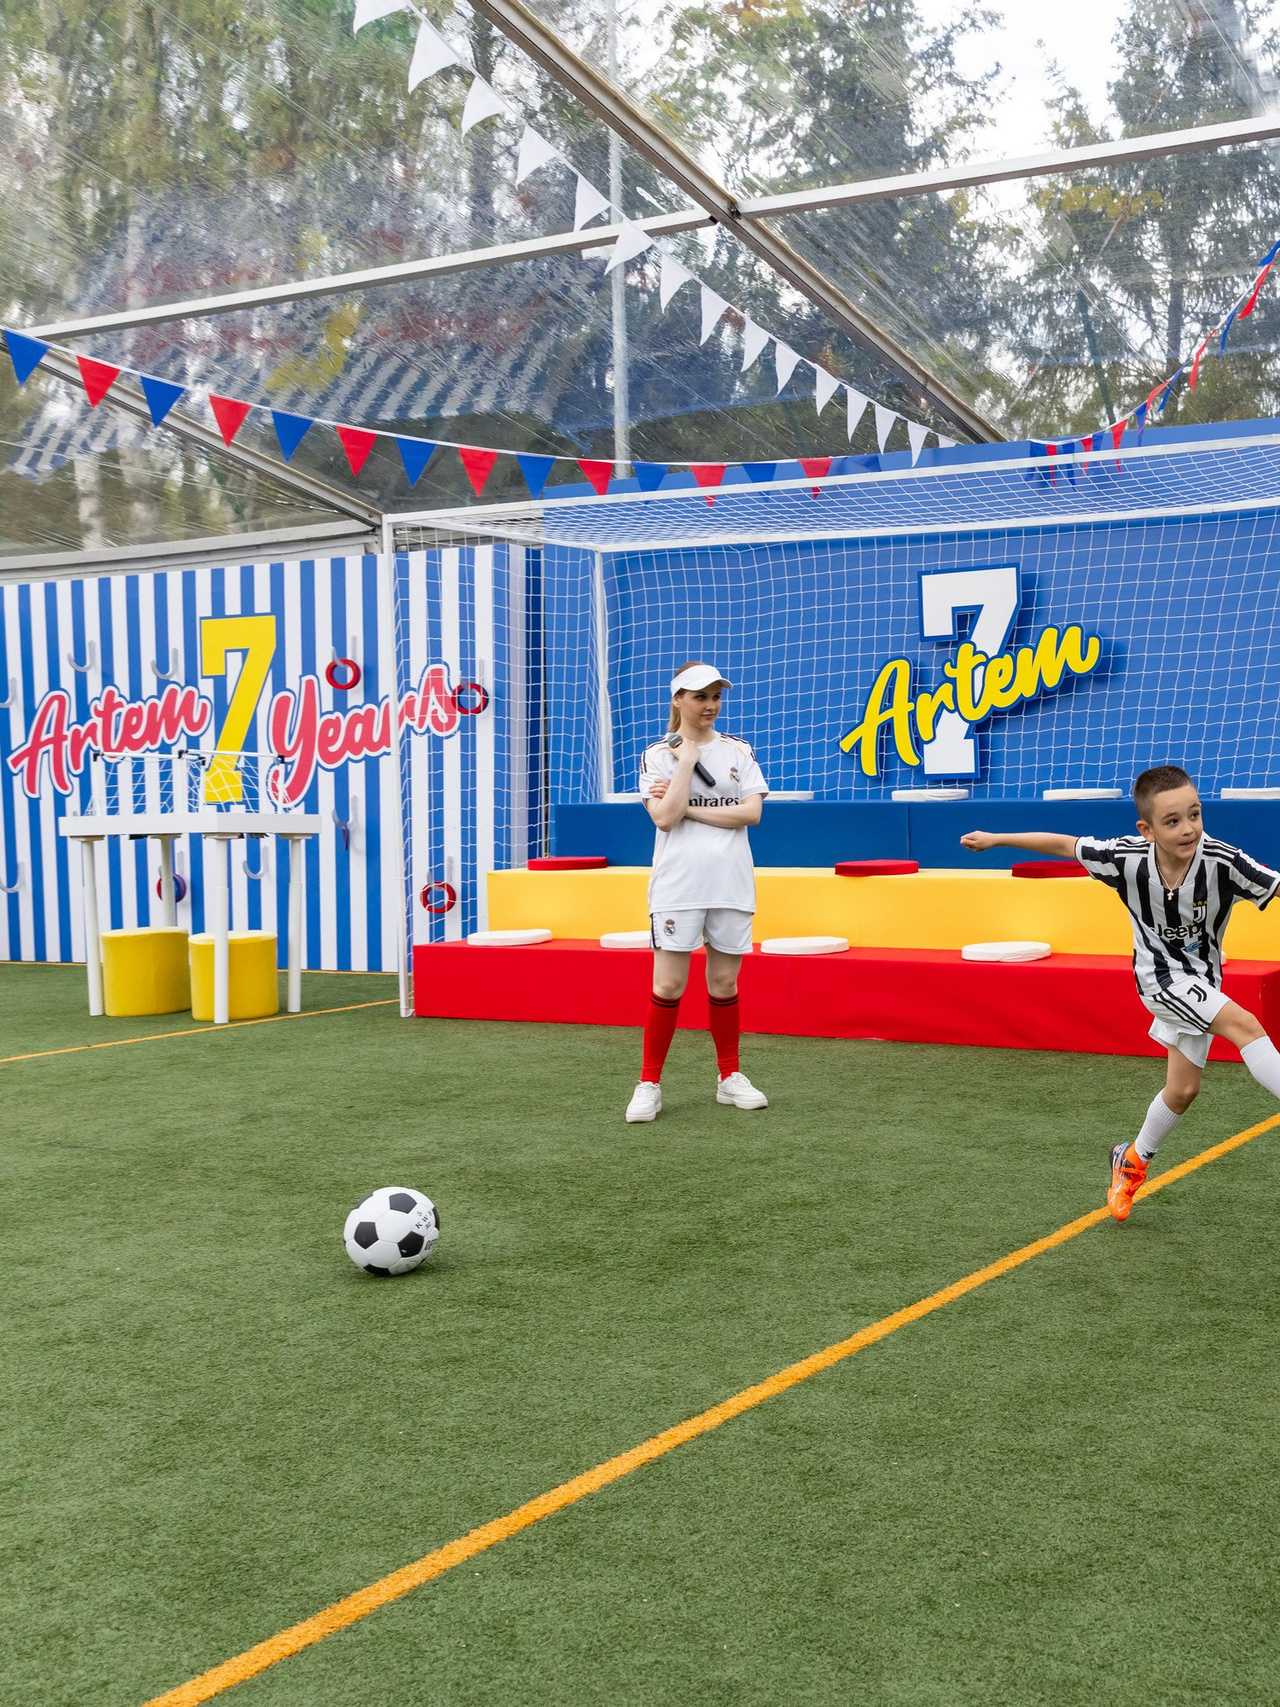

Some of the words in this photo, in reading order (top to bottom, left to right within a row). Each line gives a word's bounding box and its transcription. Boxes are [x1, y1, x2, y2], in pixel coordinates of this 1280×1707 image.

[7, 686, 211, 797] Artem
[200, 614, 277, 804] 7
[271, 667, 459, 804] Years
[839, 624, 1101, 777] Artem
[919, 565, 1018, 776] 7
[688, 795, 740, 807] mirates
[1150, 922, 1201, 940] Jeep
